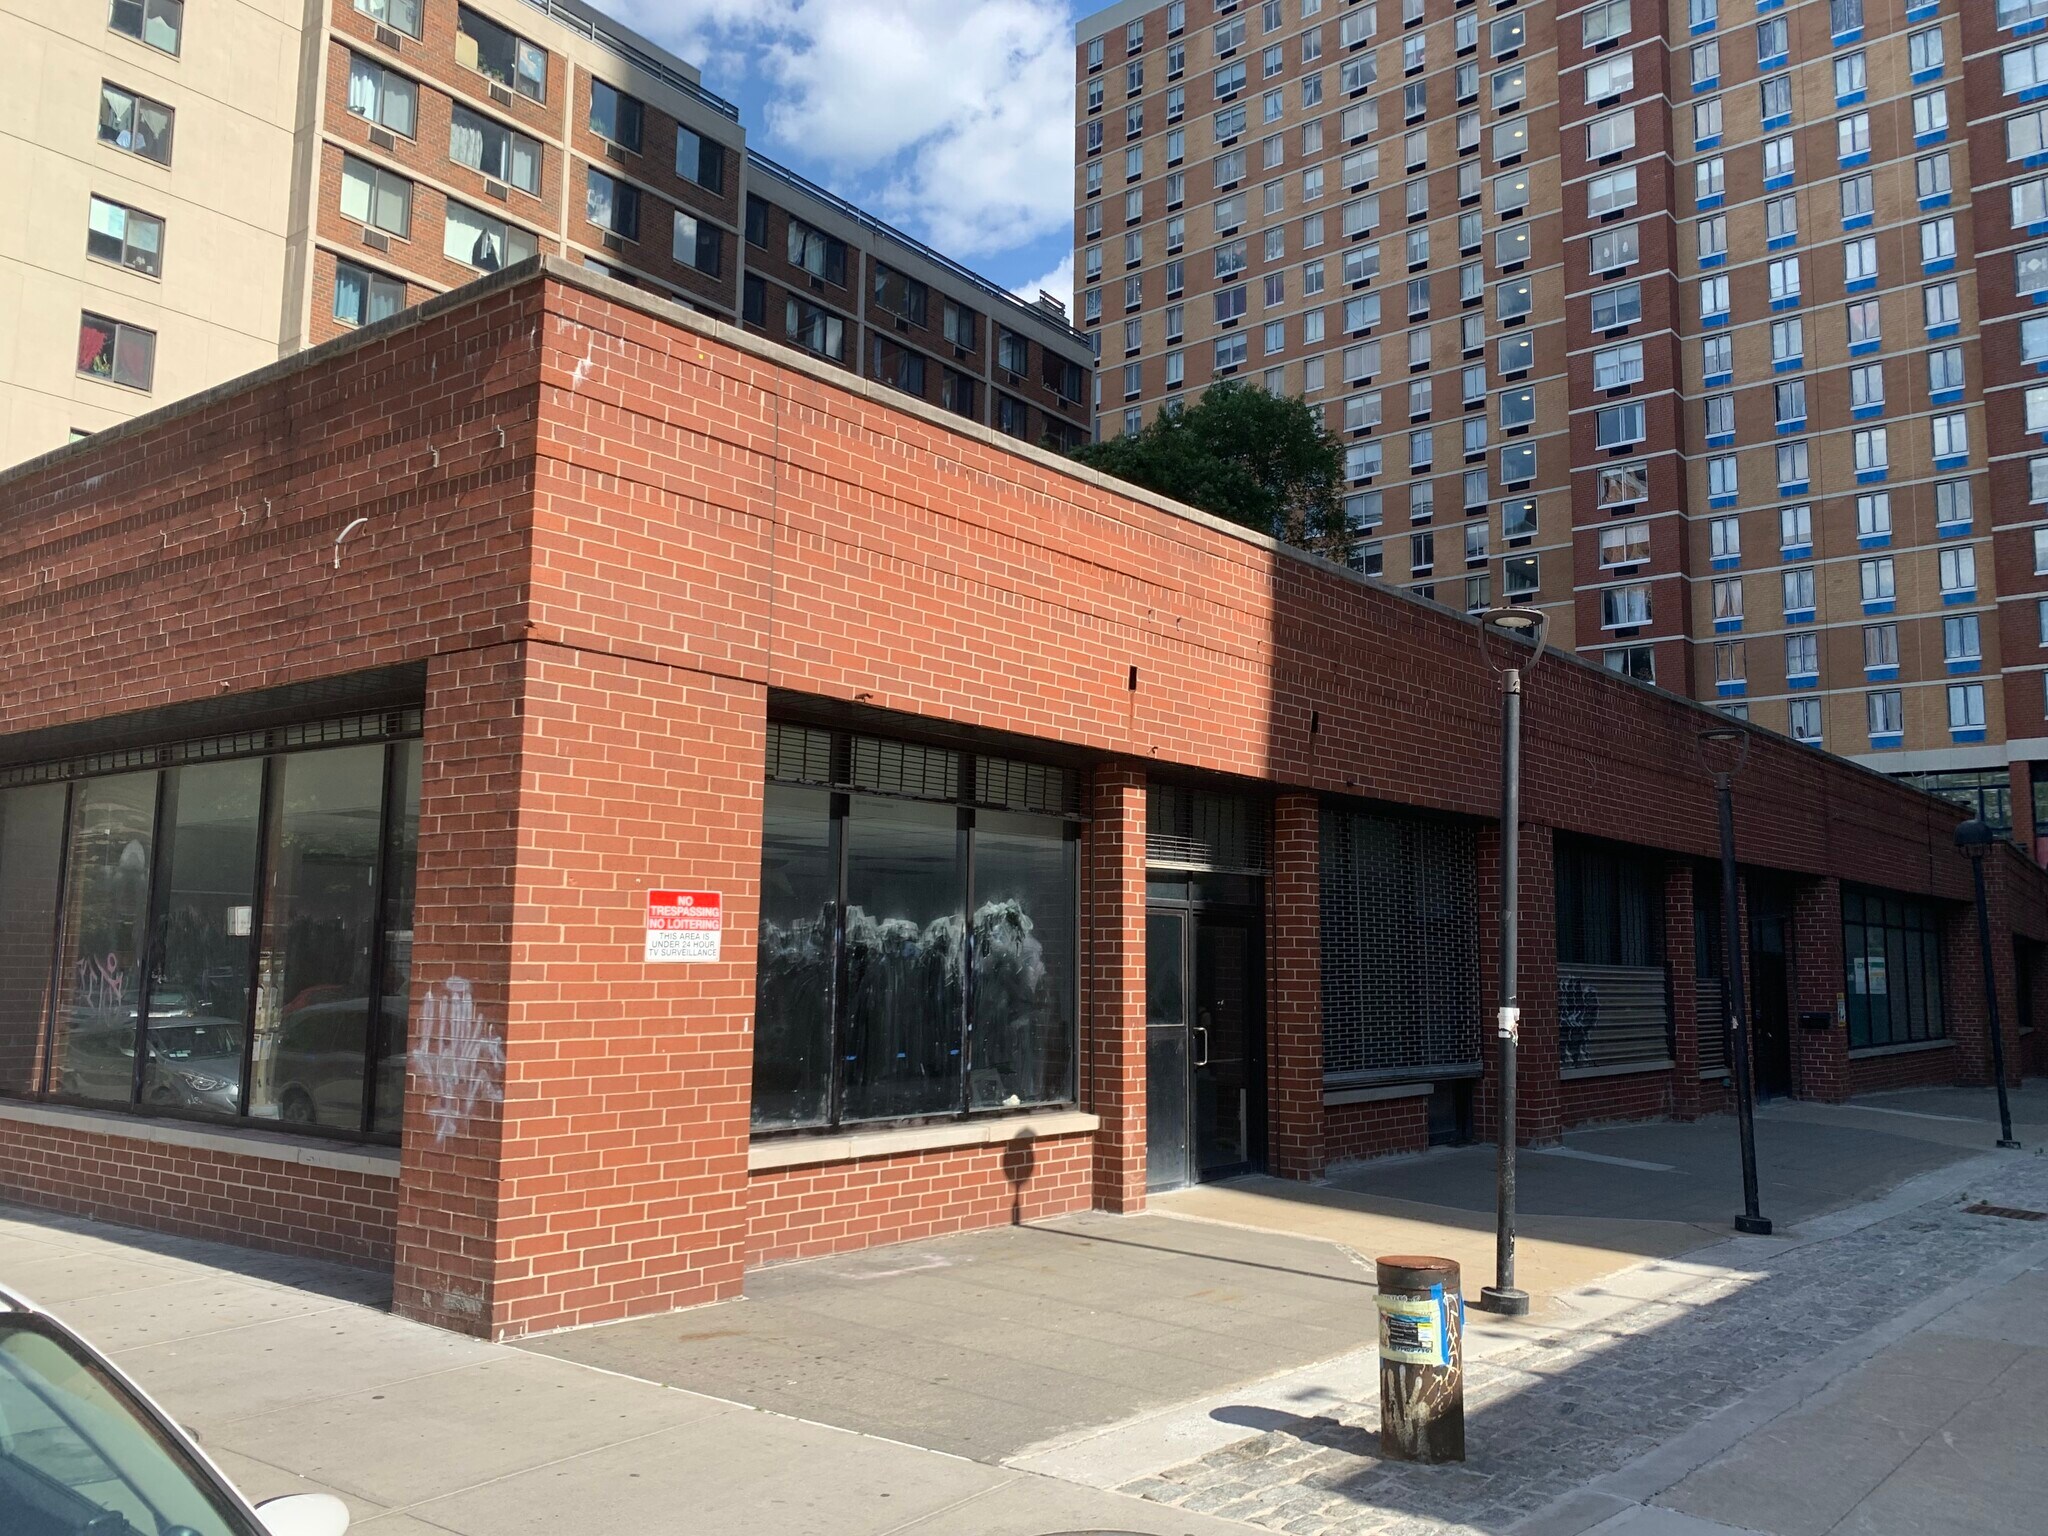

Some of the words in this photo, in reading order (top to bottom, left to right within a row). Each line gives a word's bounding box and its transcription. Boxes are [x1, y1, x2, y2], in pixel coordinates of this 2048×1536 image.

[677, 896, 694, 906] NO
[650, 905, 719, 917] TRESPASSING
[649, 919, 665, 928] NO
[667, 919, 719, 929] LOITERING
[659, 932, 677, 940] THIS
[651, 940, 680, 948] UNDER
[649, 948, 659, 956] TV
[661, 948, 717, 956] SURVEILLANCE
